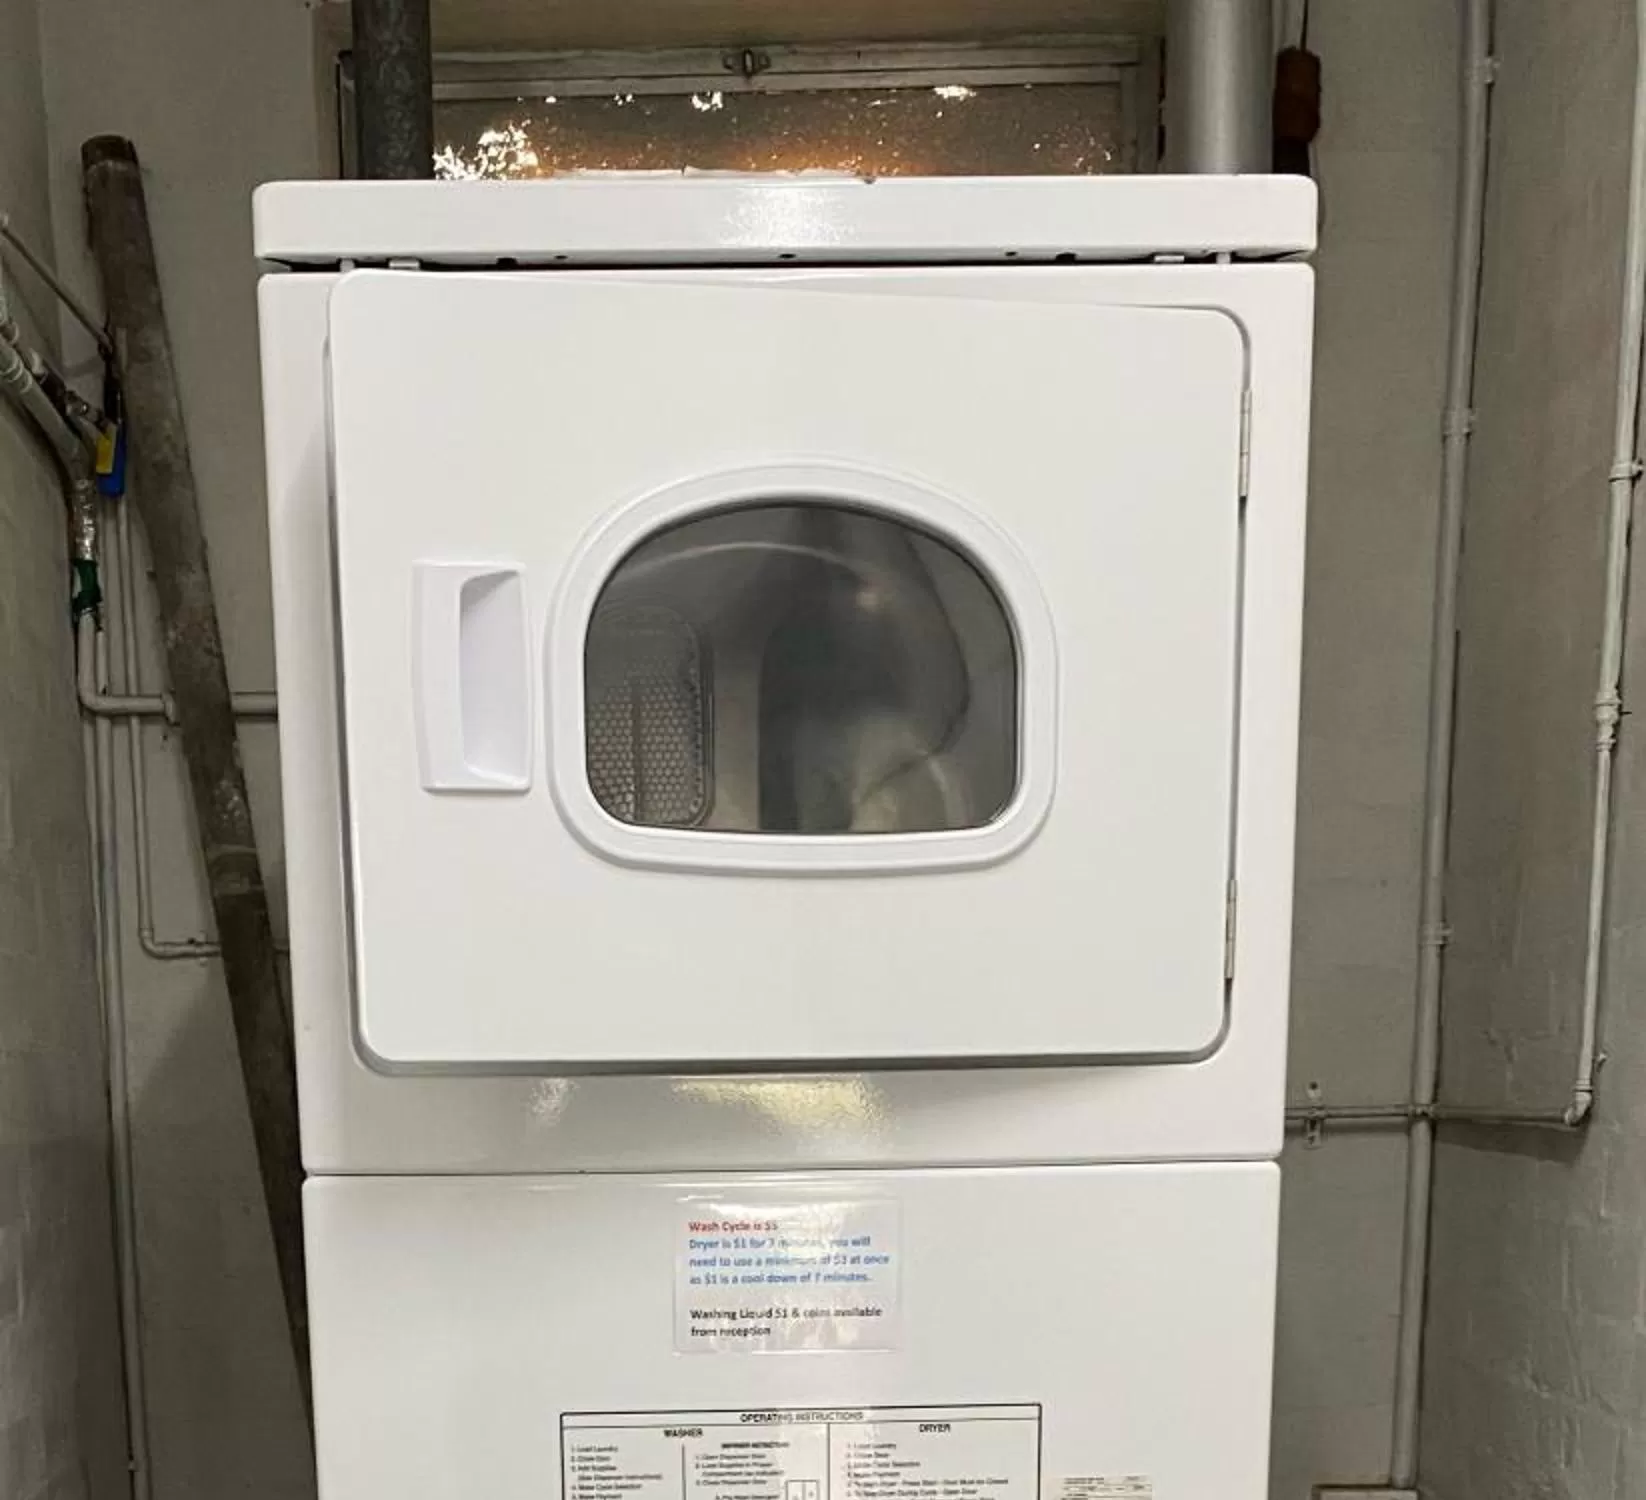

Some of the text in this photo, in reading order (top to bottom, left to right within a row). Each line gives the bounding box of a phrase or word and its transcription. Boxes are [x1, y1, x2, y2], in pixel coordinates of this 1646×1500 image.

[689, 1221, 720, 1232] Wash
[722, 1221, 750, 1233] Cycle
[689, 1238, 719, 1251] Dryer
[851, 1236, 871, 1247] will
[689, 1256, 717, 1267] need
[720, 1256, 731, 1267] to
[734, 1256, 753, 1267] use
[864, 1254, 889, 1265] once
[766, 1272, 797, 1283] down
[799, 1271, 811, 1283] of
[690, 1309, 737, 1321] Washing
[691, 1325, 771, 1338] from reception
[663, 1428, 703, 1438] WASHER
[918, 1423, 952, 1433] DRYER
